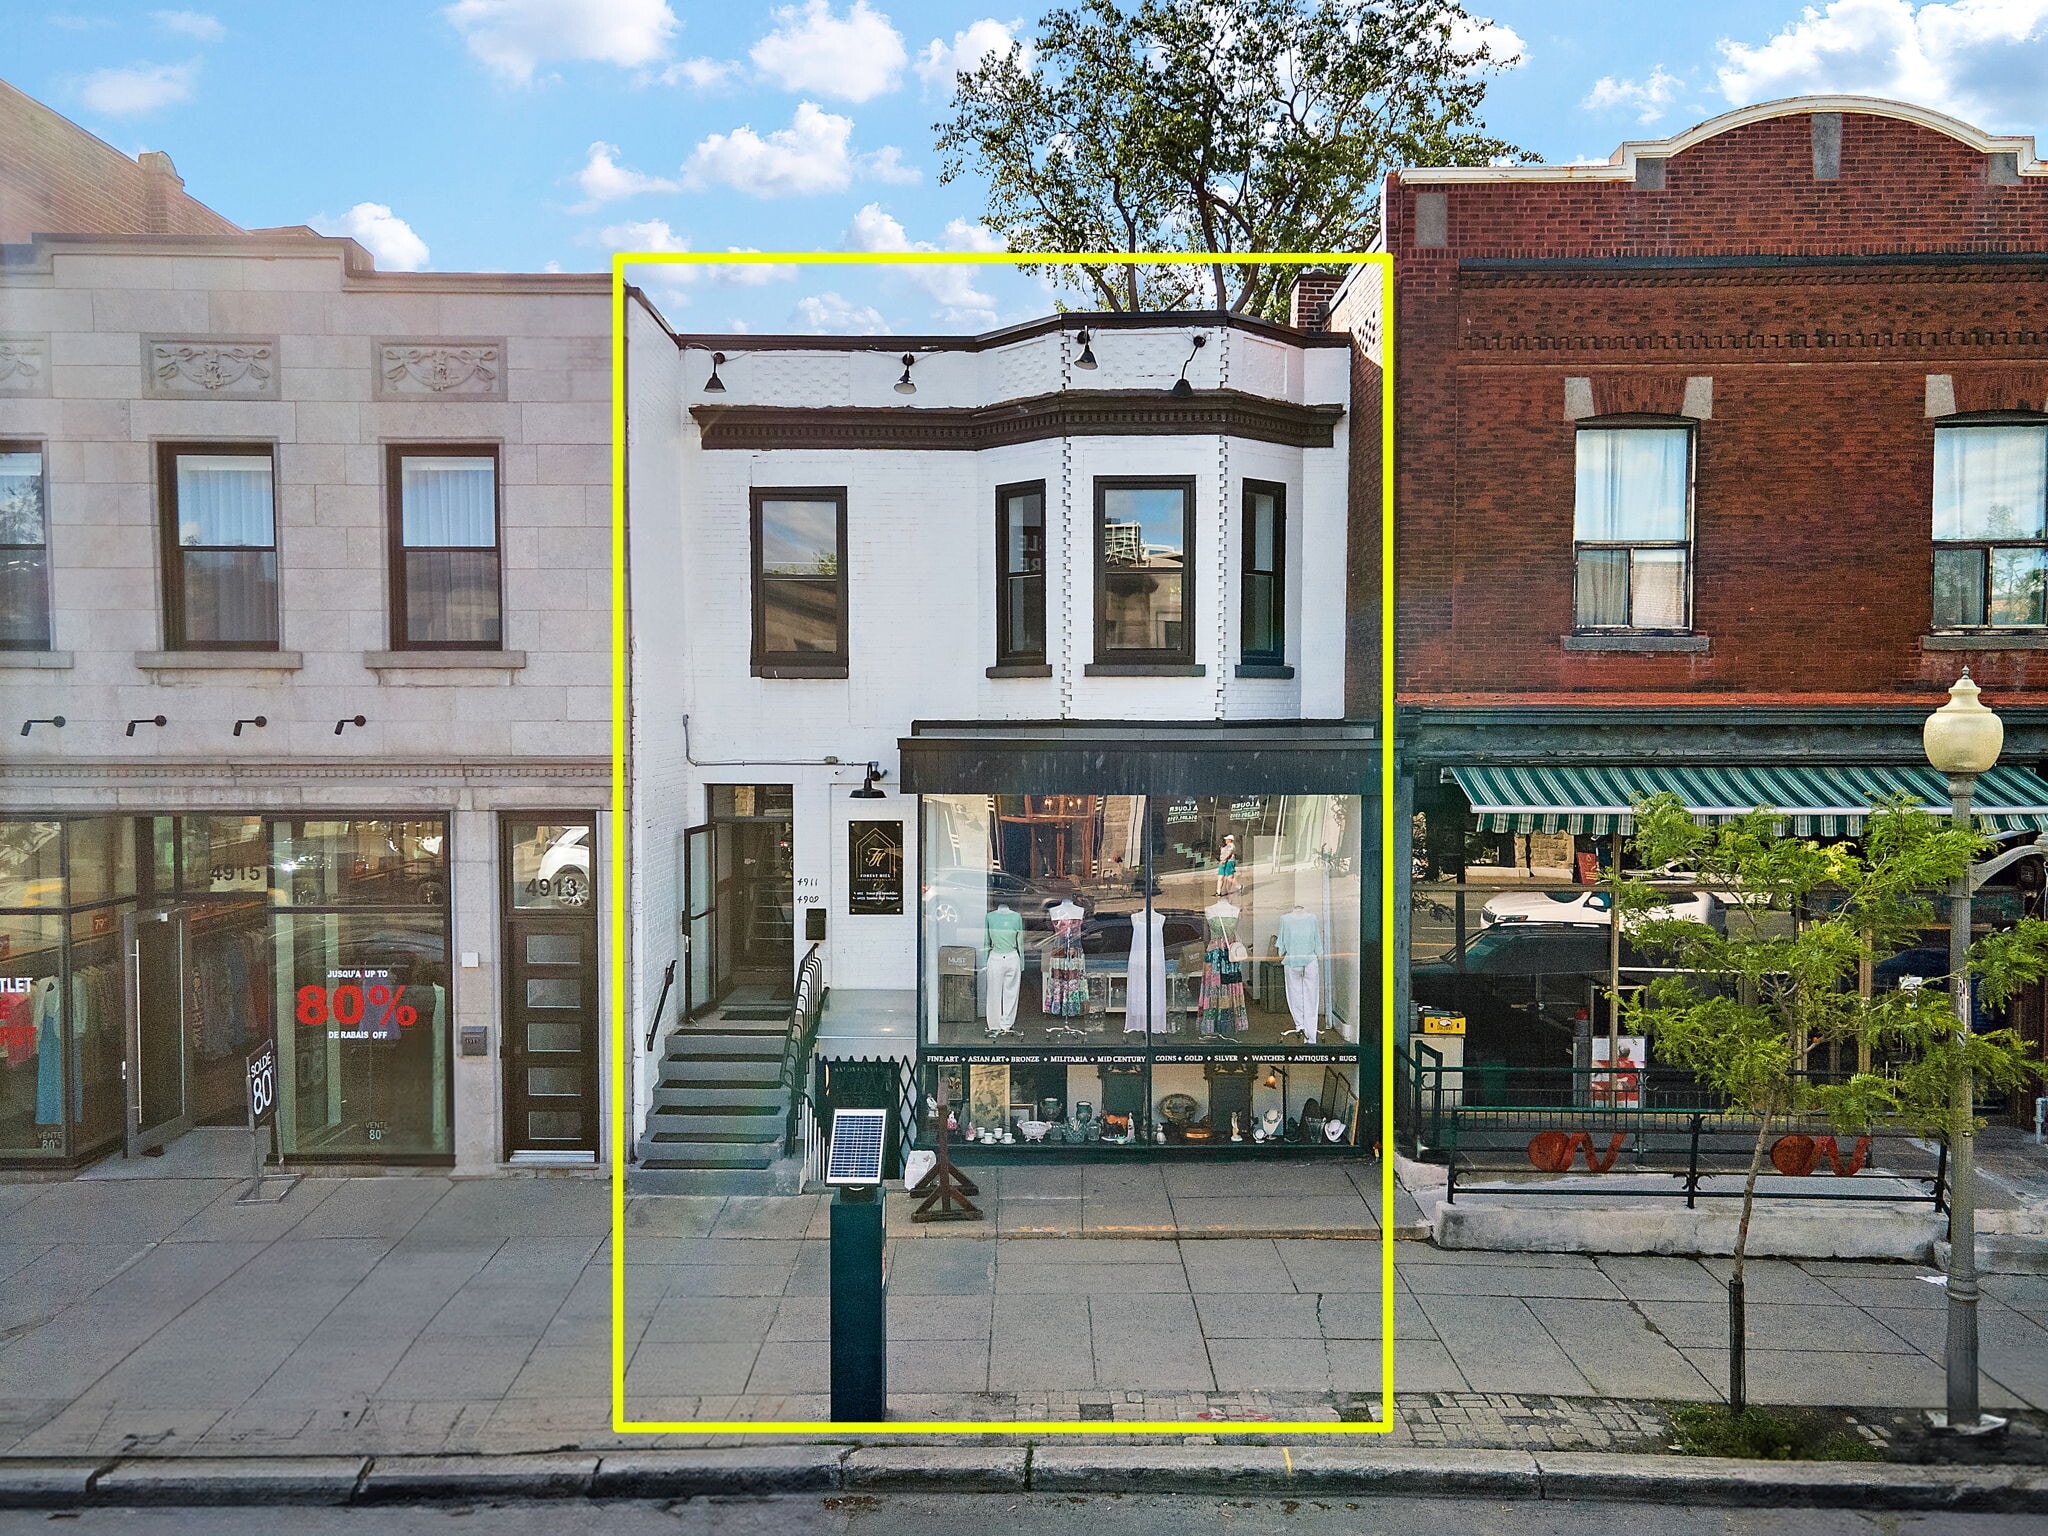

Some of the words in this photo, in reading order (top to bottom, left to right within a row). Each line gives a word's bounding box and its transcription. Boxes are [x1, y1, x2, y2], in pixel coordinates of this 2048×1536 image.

[210, 864, 260, 881] 4915
[797, 878, 818, 887] 4911
[525, 878, 578, 897] 4913
[364, 970, 376, 978] UP
[377, 970, 388, 978] TO
[296, 985, 417, 1026] 80%
[328, 1031, 340, 1039] DE
[340, 1031, 369, 1039] RABAIS
[372, 1031, 388, 1039] OFF
[926, 1055, 944, 1063] FINE
[944, 1055, 960, 1063] ART
[967, 1055, 991, 1063] ASIAN
[991, 1055, 1006, 1063] ART
[1010, 1055, 1040, 1063] BRONZE
[1050, 1055, 1088, 1063] MILITARIA
[1097, 1055, 1112, 1063] MID
[1112, 1055, 1146, 1063] CENTURY
[1251, 1054, 1286, 1062] WATCHES
[1293, 1054, 1329, 1063] ANTIQUES
[250, 1051, 272, 1078] SOLDE
[365, 1121, 389, 1129] VENTE
[37, 1131, 63, 1139] VENTE
